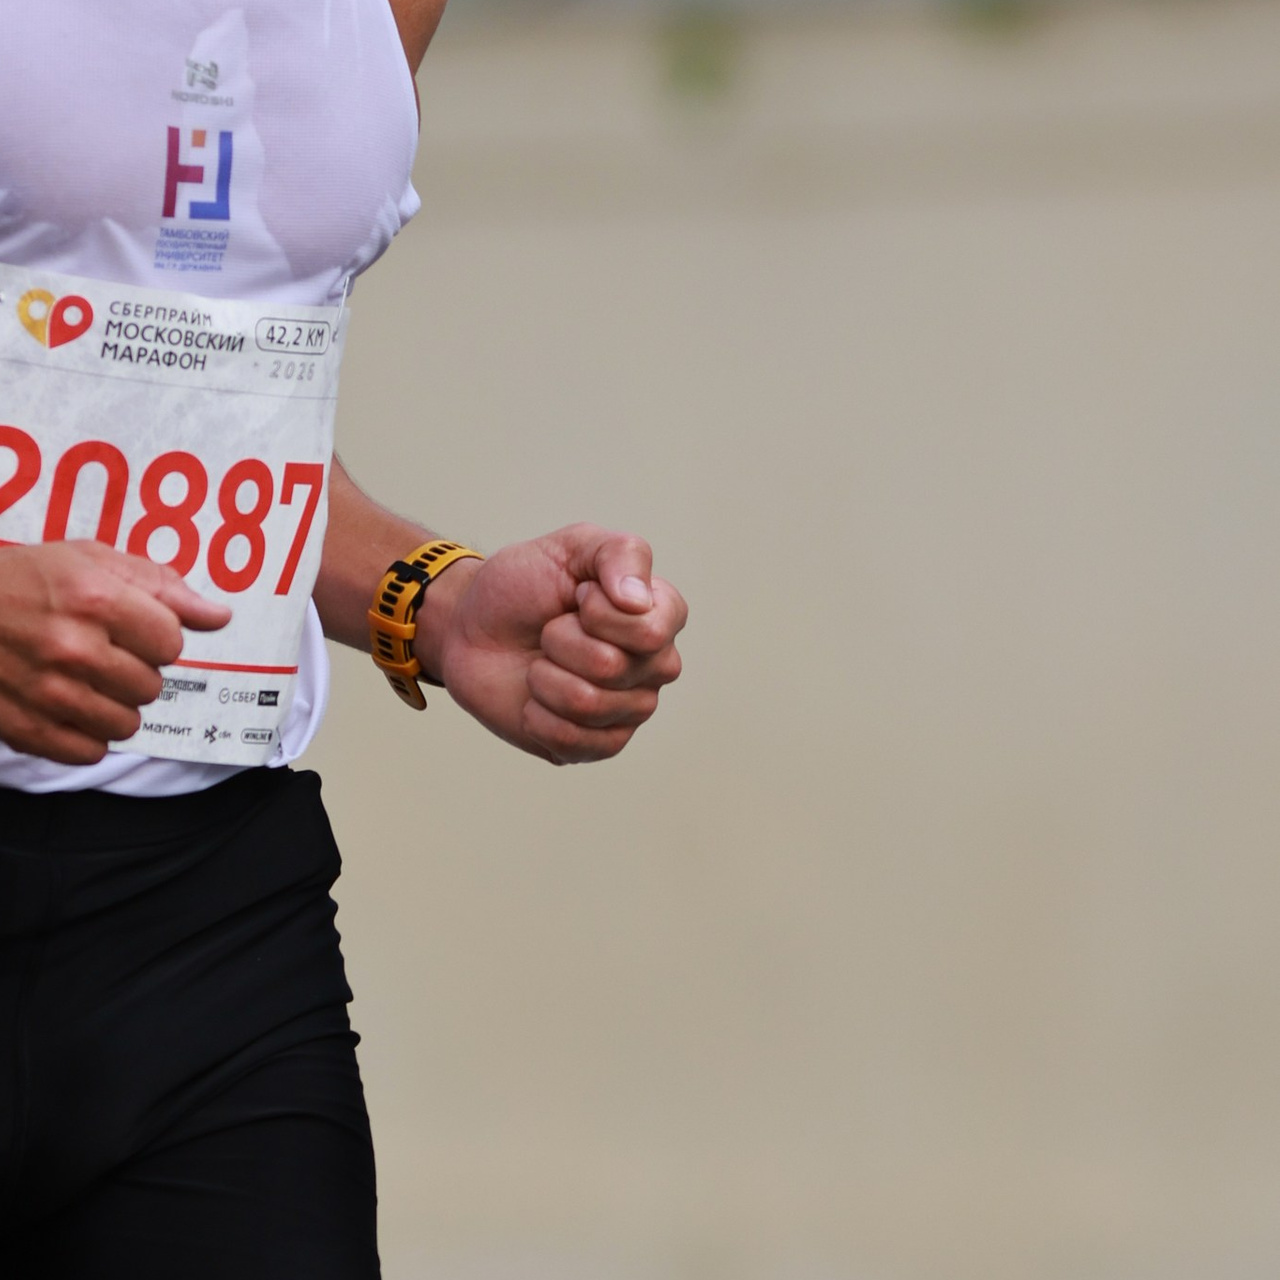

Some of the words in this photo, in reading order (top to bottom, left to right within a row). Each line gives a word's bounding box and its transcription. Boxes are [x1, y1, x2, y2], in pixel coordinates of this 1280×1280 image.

[109, 301, 212, 326] СБЕРПРАЙМ
[104, 320, 245, 352] МОСКОВСКИЙ
[266, 325, 303, 347] 42,2
[100, 342, 207, 371] МАРАФОН
[162, 678, 207, 693] ОСКОВСКИЙ
[158, 690, 179, 703] ПОРТ
[232, 692, 257, 703] СБЕР
[142, 722, 193, 737] магнит
